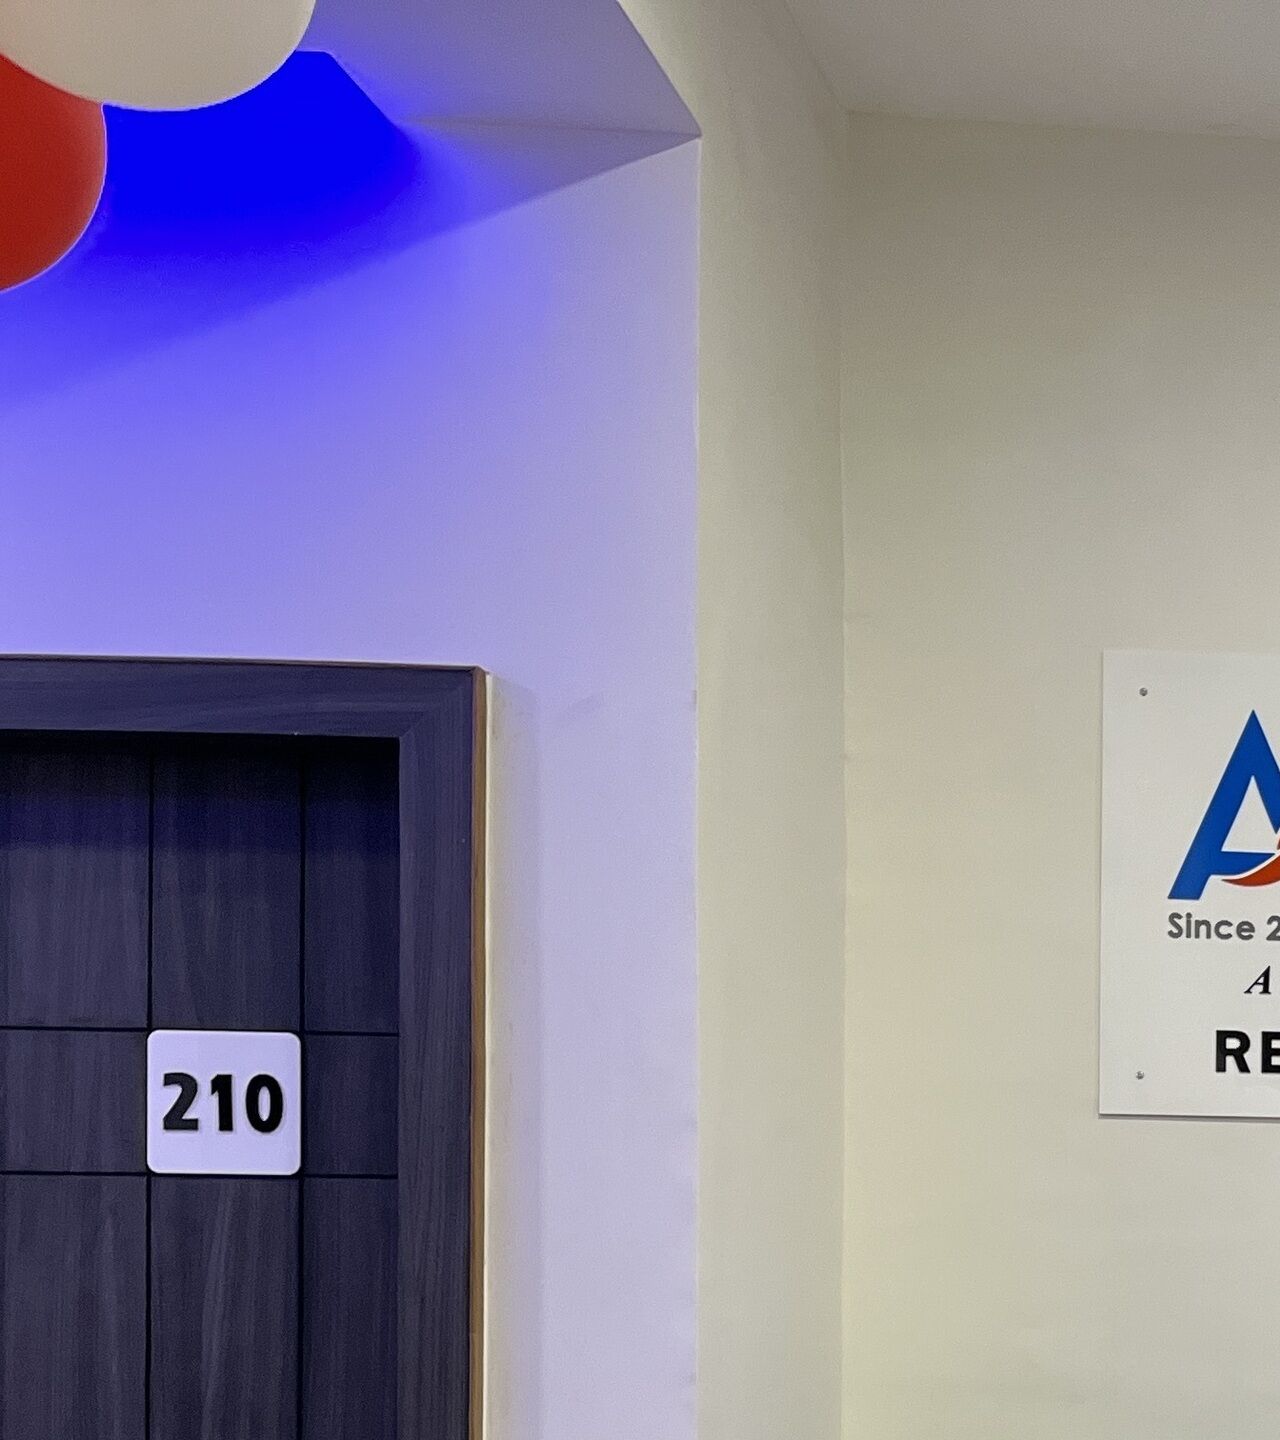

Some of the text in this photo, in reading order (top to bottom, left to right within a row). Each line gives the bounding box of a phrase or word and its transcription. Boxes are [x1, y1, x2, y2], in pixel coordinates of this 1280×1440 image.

[1167, 911, 1256, 942] Since
[1243, 965, 1273, 996] A
[162, 1072, 284, 1134] 210
